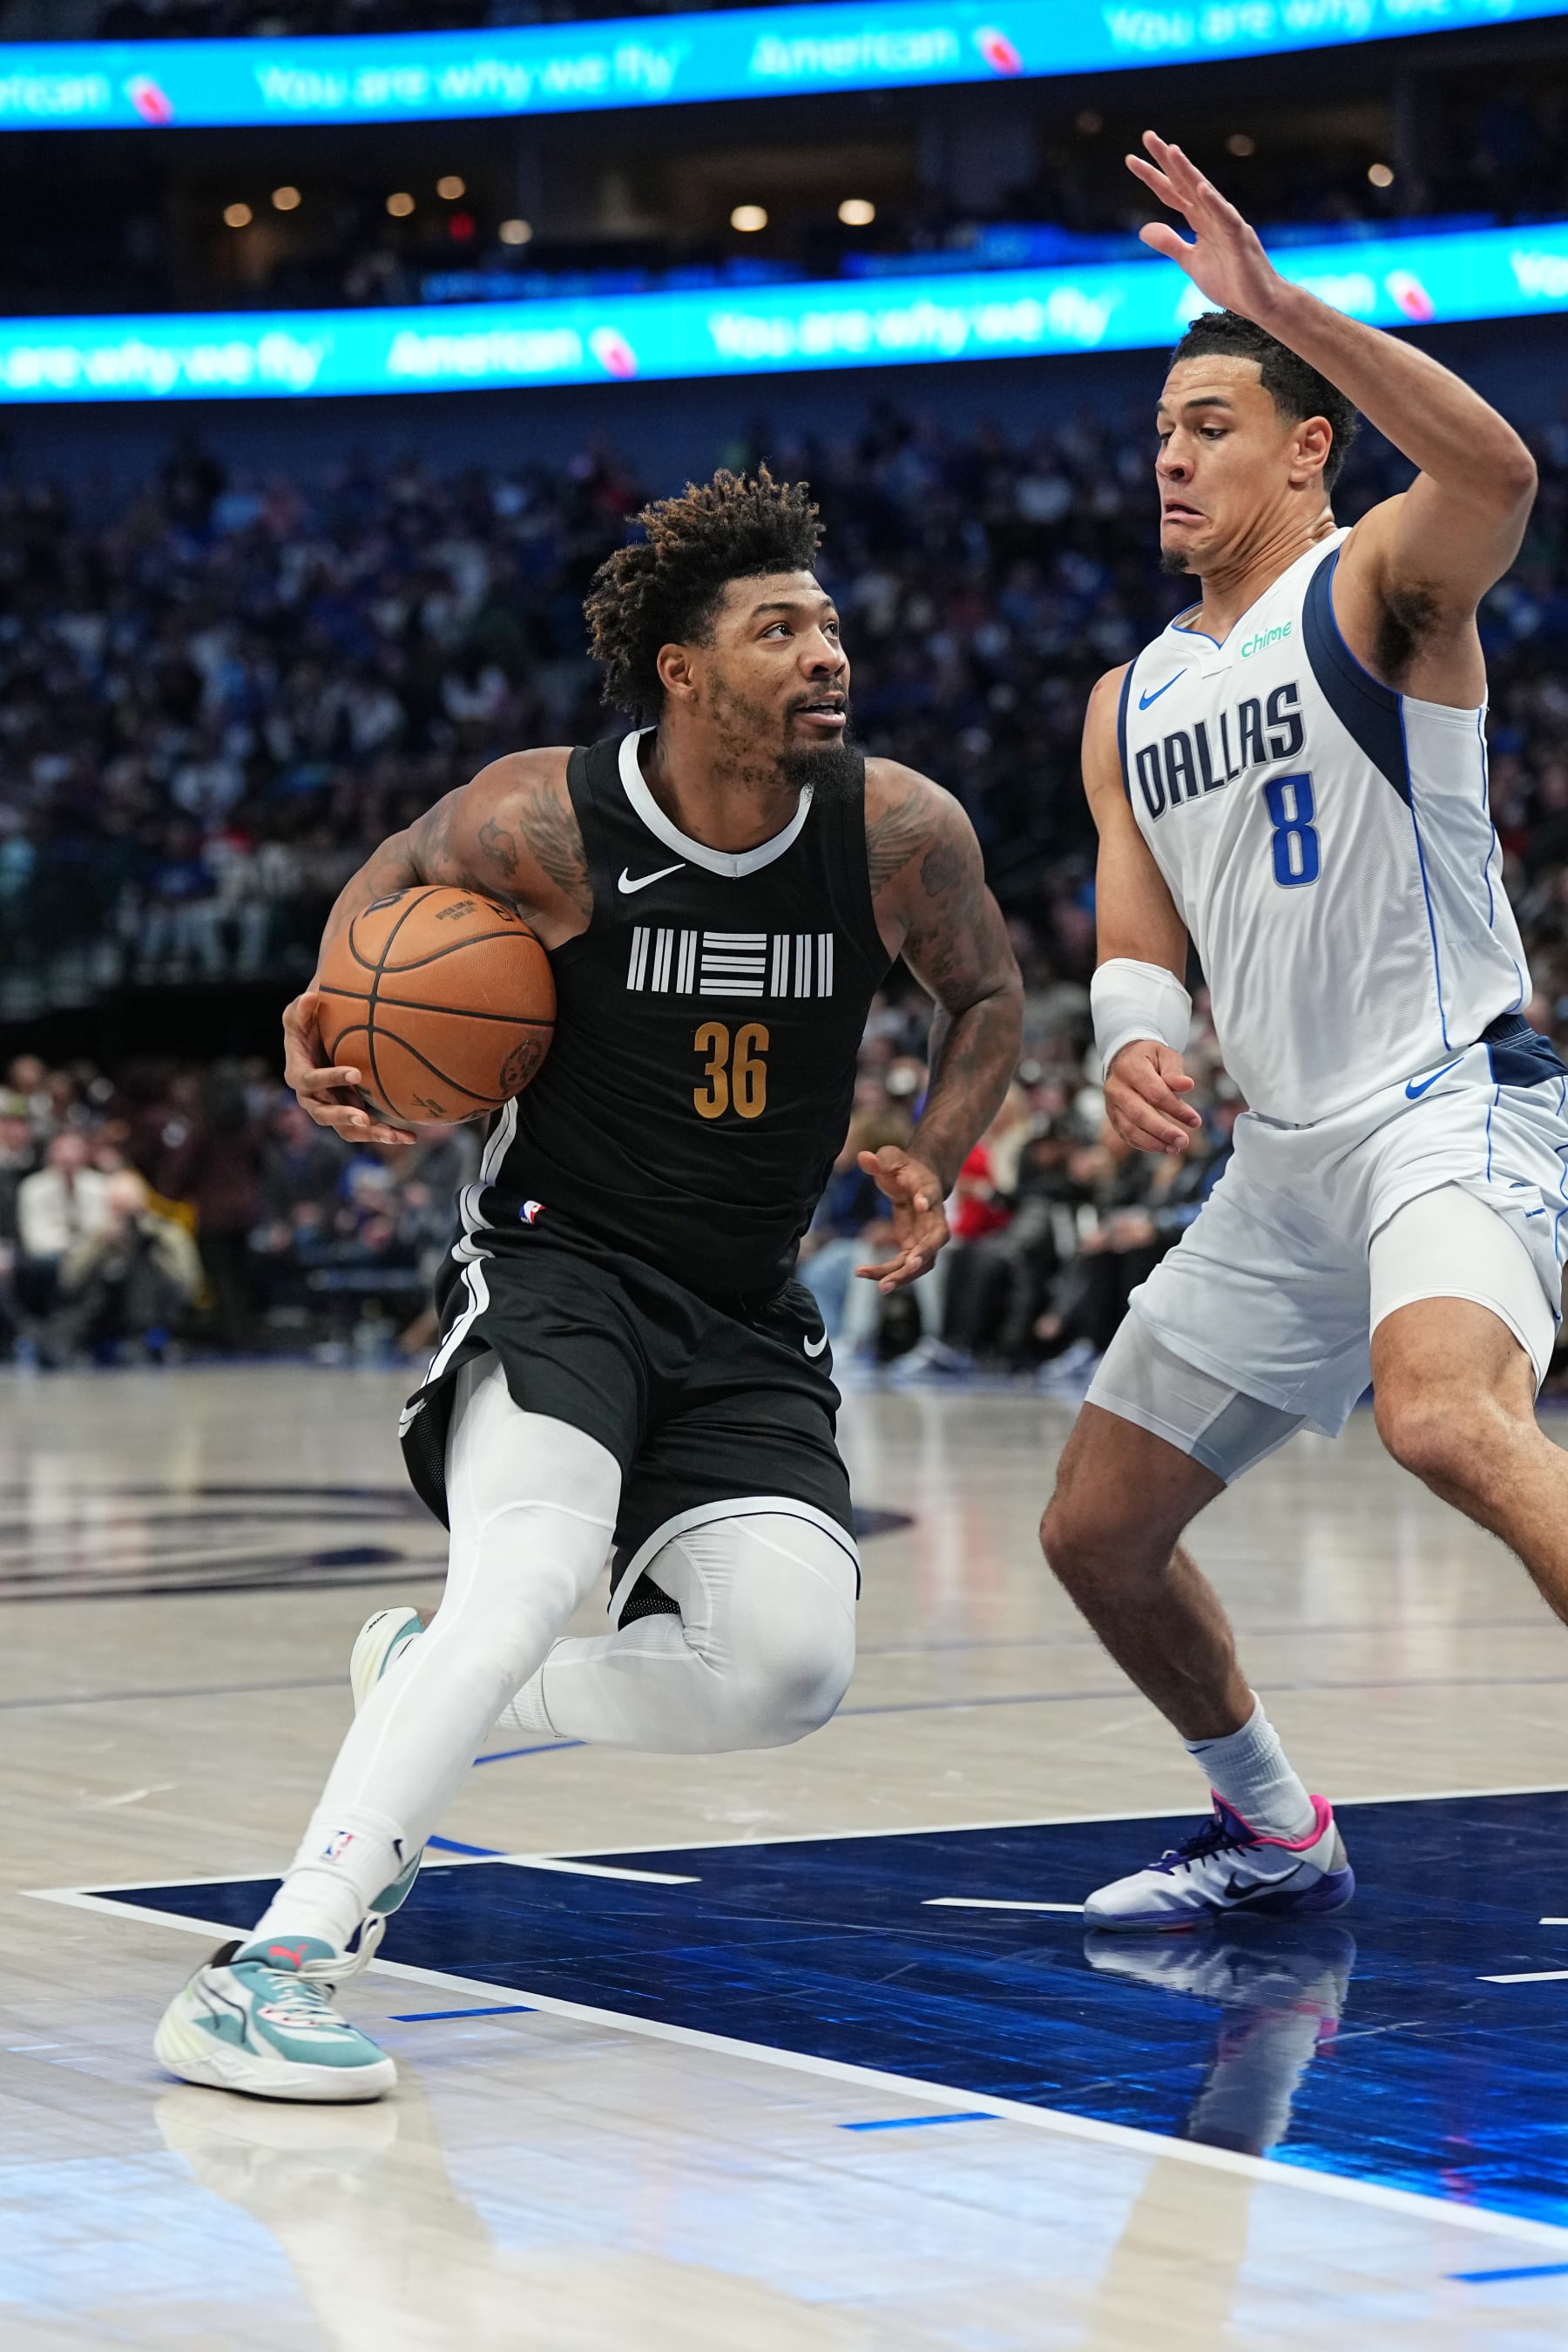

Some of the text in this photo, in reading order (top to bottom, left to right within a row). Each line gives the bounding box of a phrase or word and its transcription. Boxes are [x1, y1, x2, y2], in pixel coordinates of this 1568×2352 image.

[255, 64, 348, 109] You
[350, 66, 431, 106] are
[434, 57, 534, 108] why
[537, 54, 611, 94] we
[750, 27, 959, 77] American
[383, 326, 584, 379] American
[706, 309, 794, 360] You
[796, 308, 873, 355] are
[874, 297, 971, 356] why
[972, 296, 1046, 343] we
[3, 343, 84, 389] are
[84, 335, 178, 395] why
[182, 340, 256, 385] we
[1241, 621, 1291, 658] chime
[1134, 679, 1306, 823] DALLAS
[1263, 770, 1321, 889] 8
[693, 1021, 769, 1119] 36
